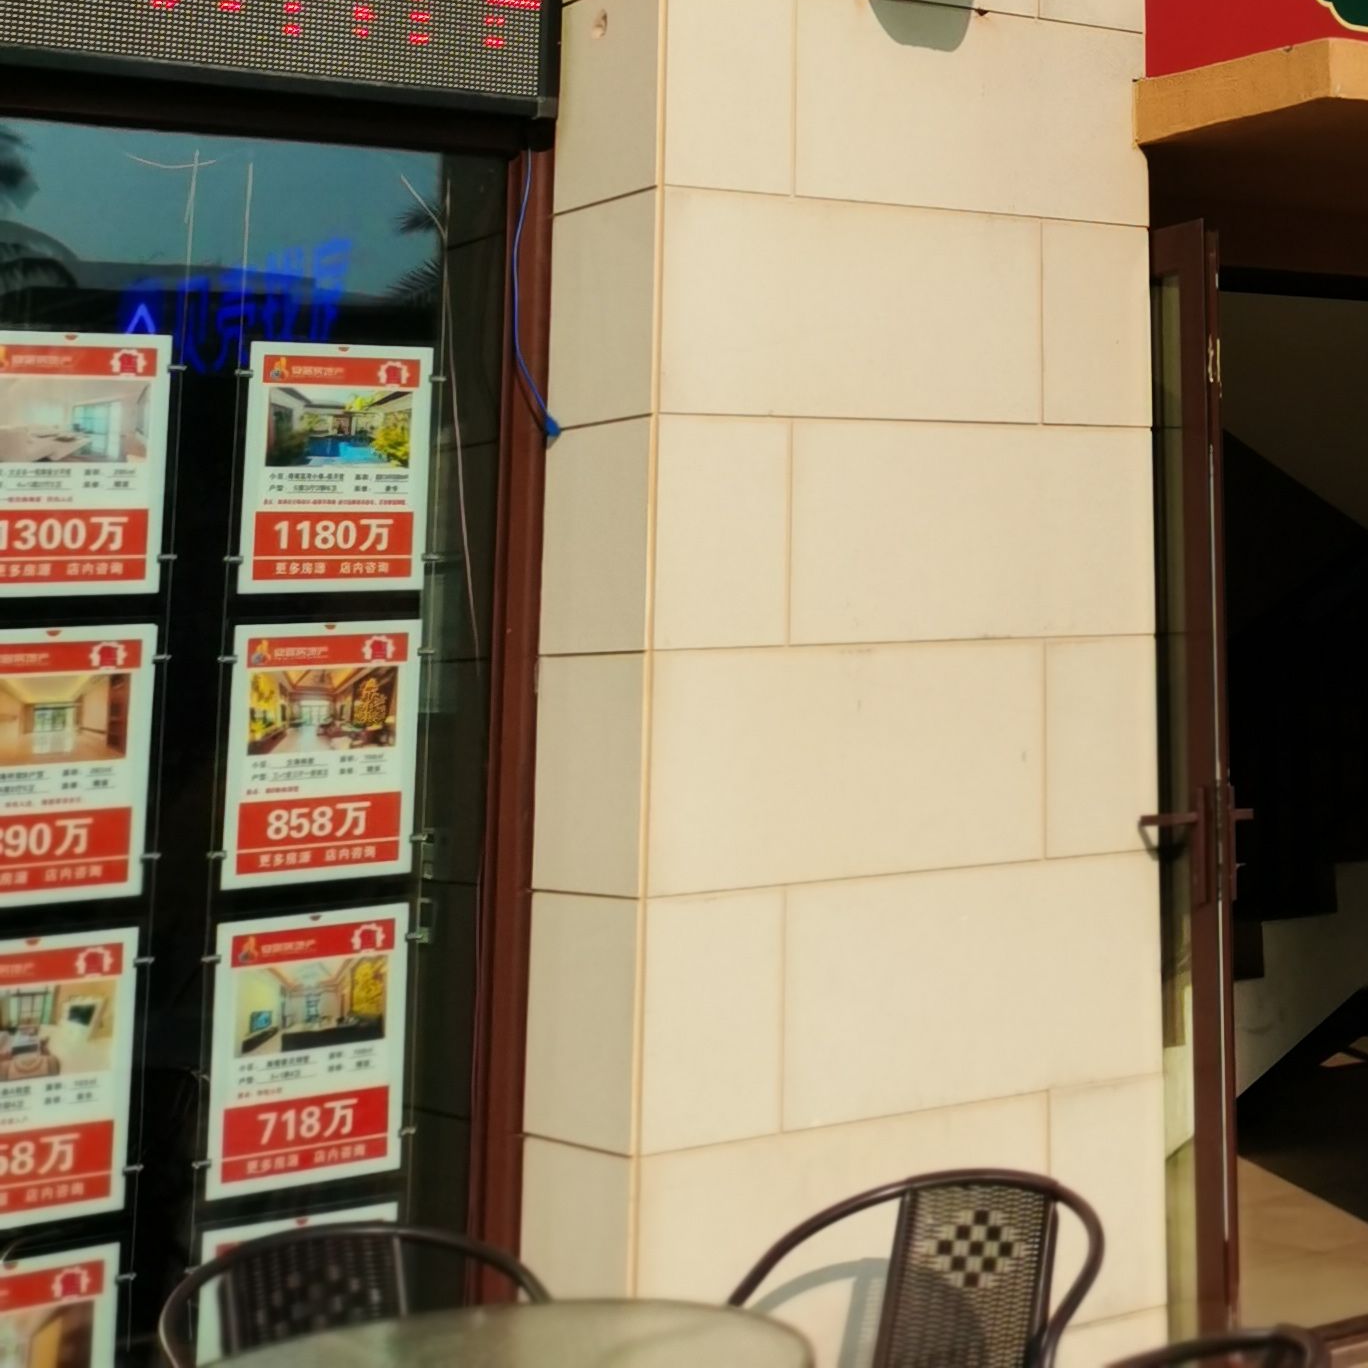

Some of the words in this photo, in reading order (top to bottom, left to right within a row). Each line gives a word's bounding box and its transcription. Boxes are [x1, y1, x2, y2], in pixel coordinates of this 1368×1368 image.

[0, 516, 129, 551] 1300万
[274, 518, 394, 552] 1180万
[0, 817, 94, 858] 90万
[266, 801, 372, 841] 858万
[257, 1098, 359, 1145] 718万
